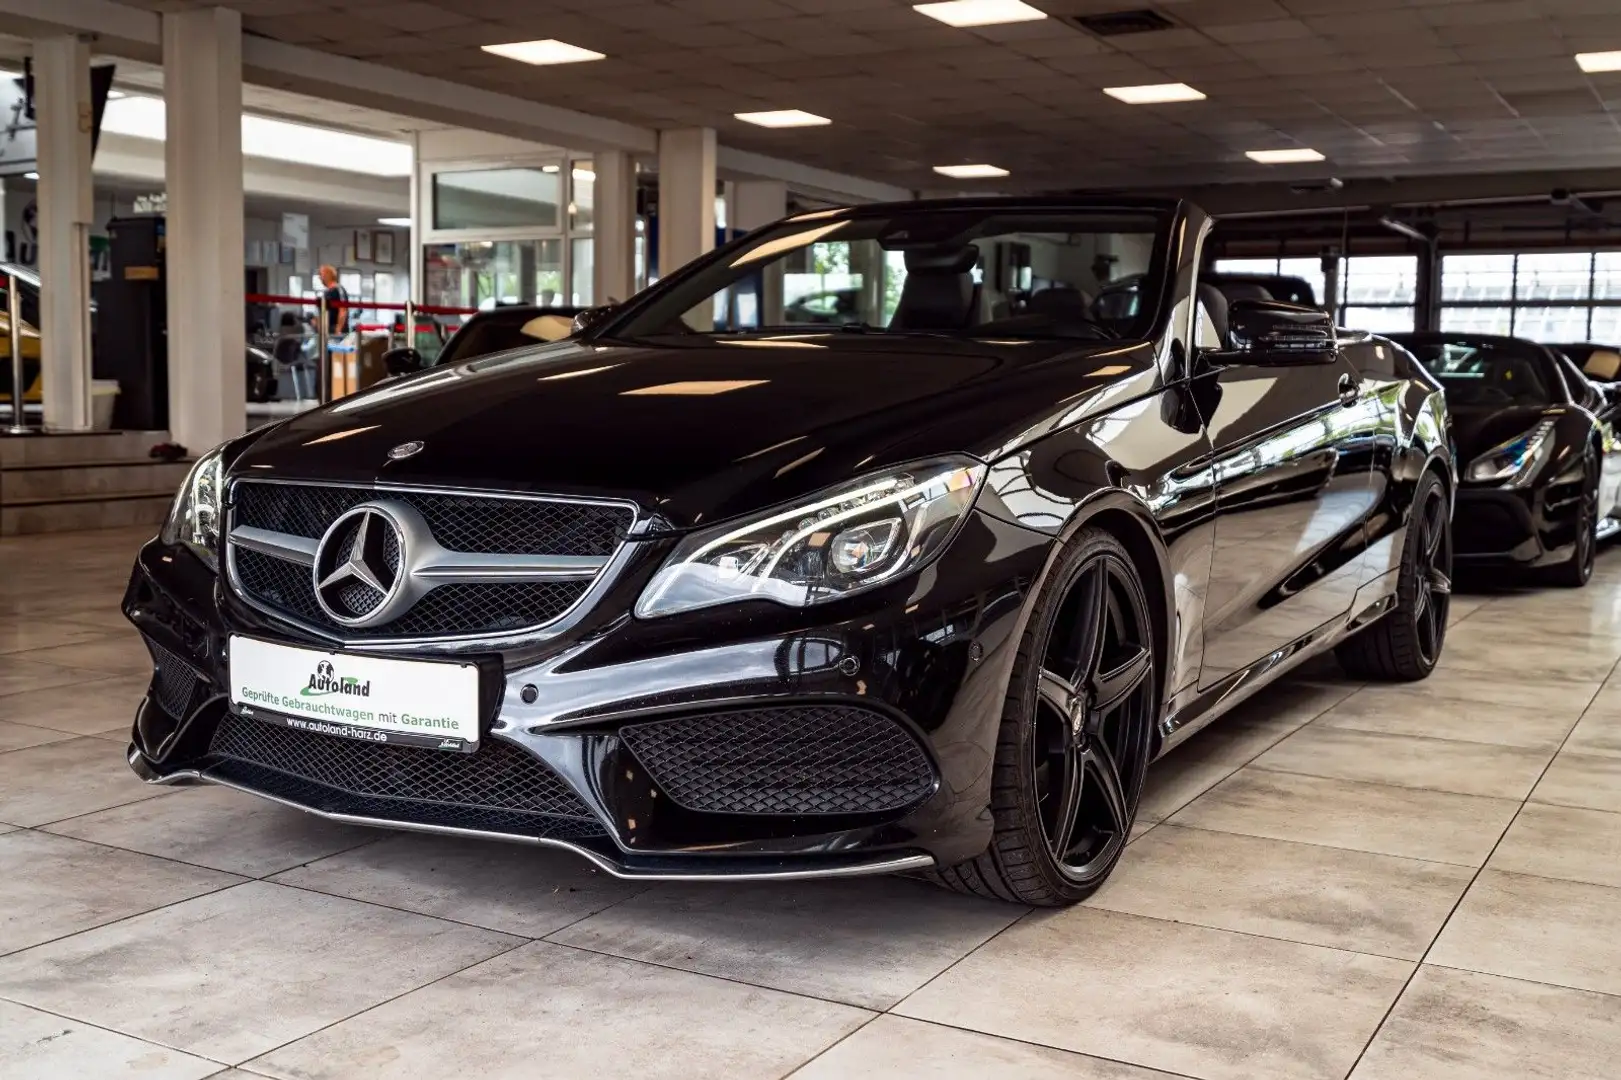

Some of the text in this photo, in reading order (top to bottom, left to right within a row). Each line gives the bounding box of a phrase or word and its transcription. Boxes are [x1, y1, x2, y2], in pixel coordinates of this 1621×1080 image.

[308, 673, 370, 697] Autoland
[242, 686, 460, 730] Geprüfte Gebrauchtwagen mit Garantie
[287, 717, 388, 742] www.autoland-harz.de
